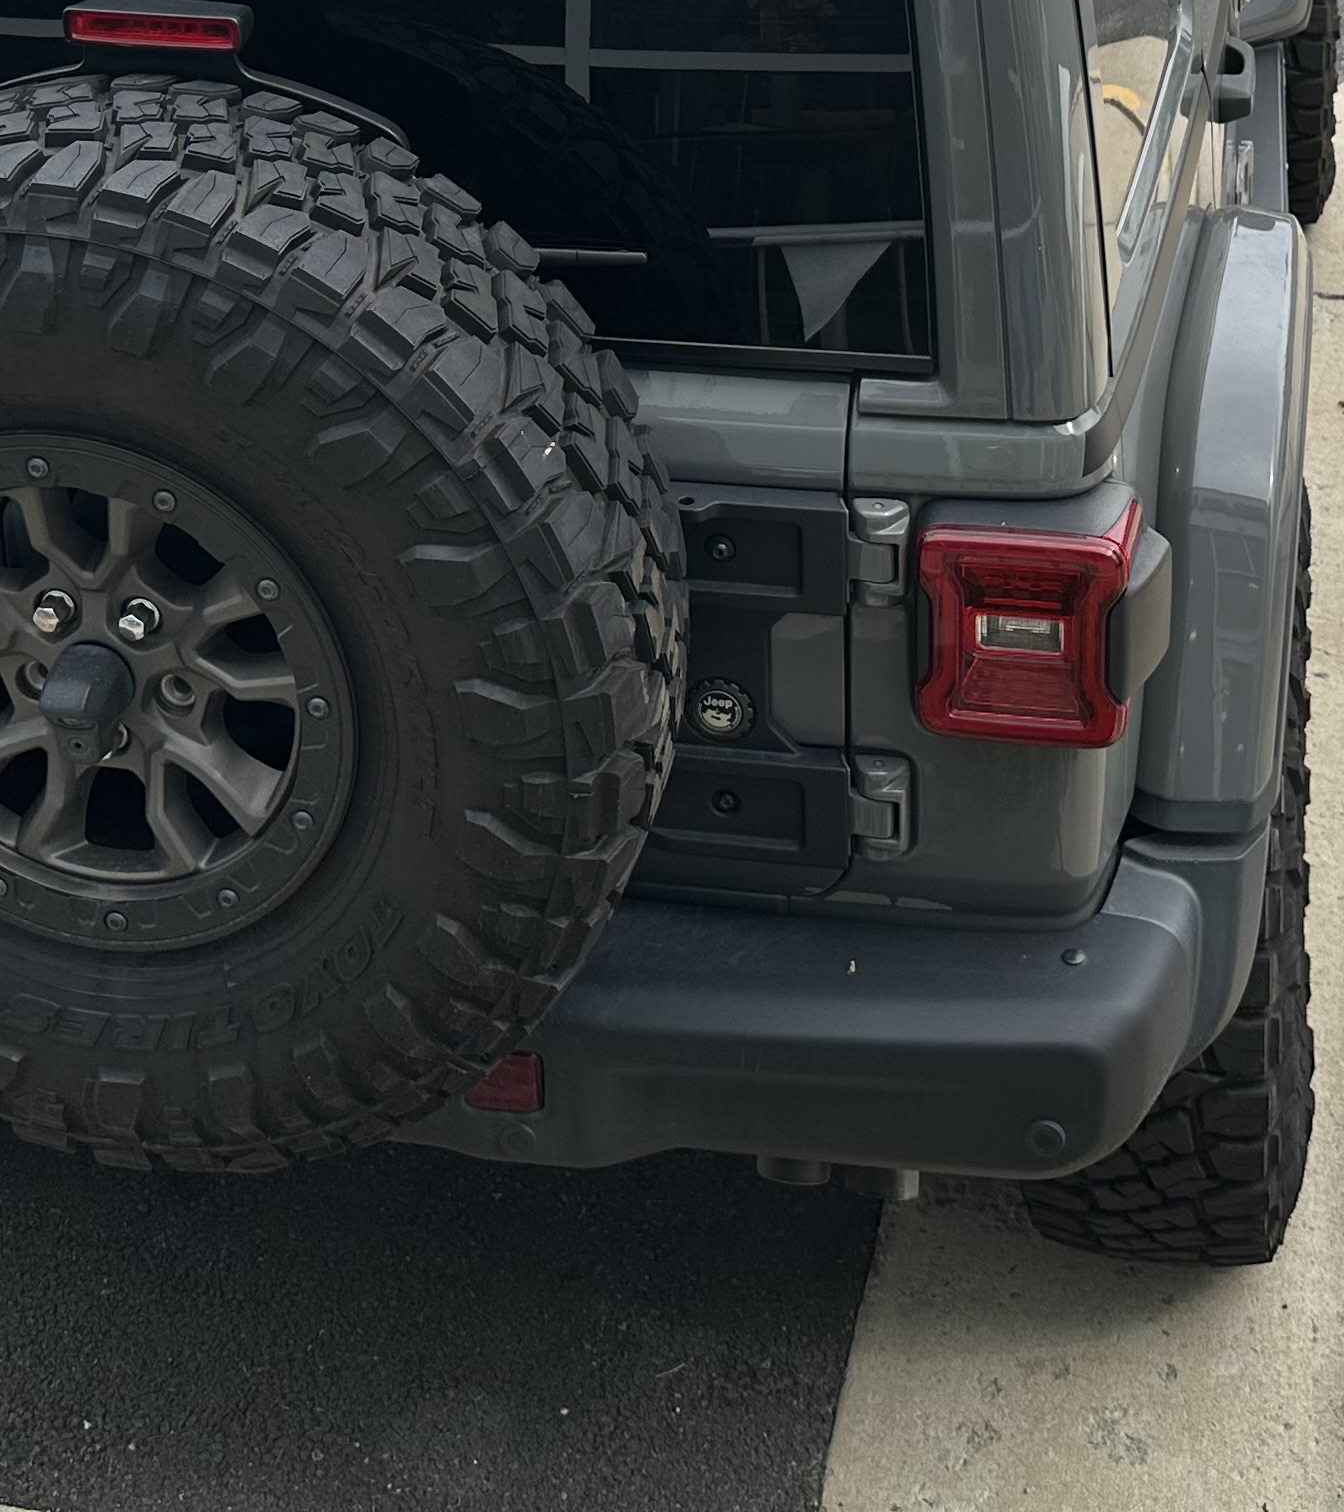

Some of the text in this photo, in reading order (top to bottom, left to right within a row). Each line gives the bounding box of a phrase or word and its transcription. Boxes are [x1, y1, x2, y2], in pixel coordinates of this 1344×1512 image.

[703, 696, 733, 709] Jeep
[0, 890, 404, 1052] TOYO TIRES
